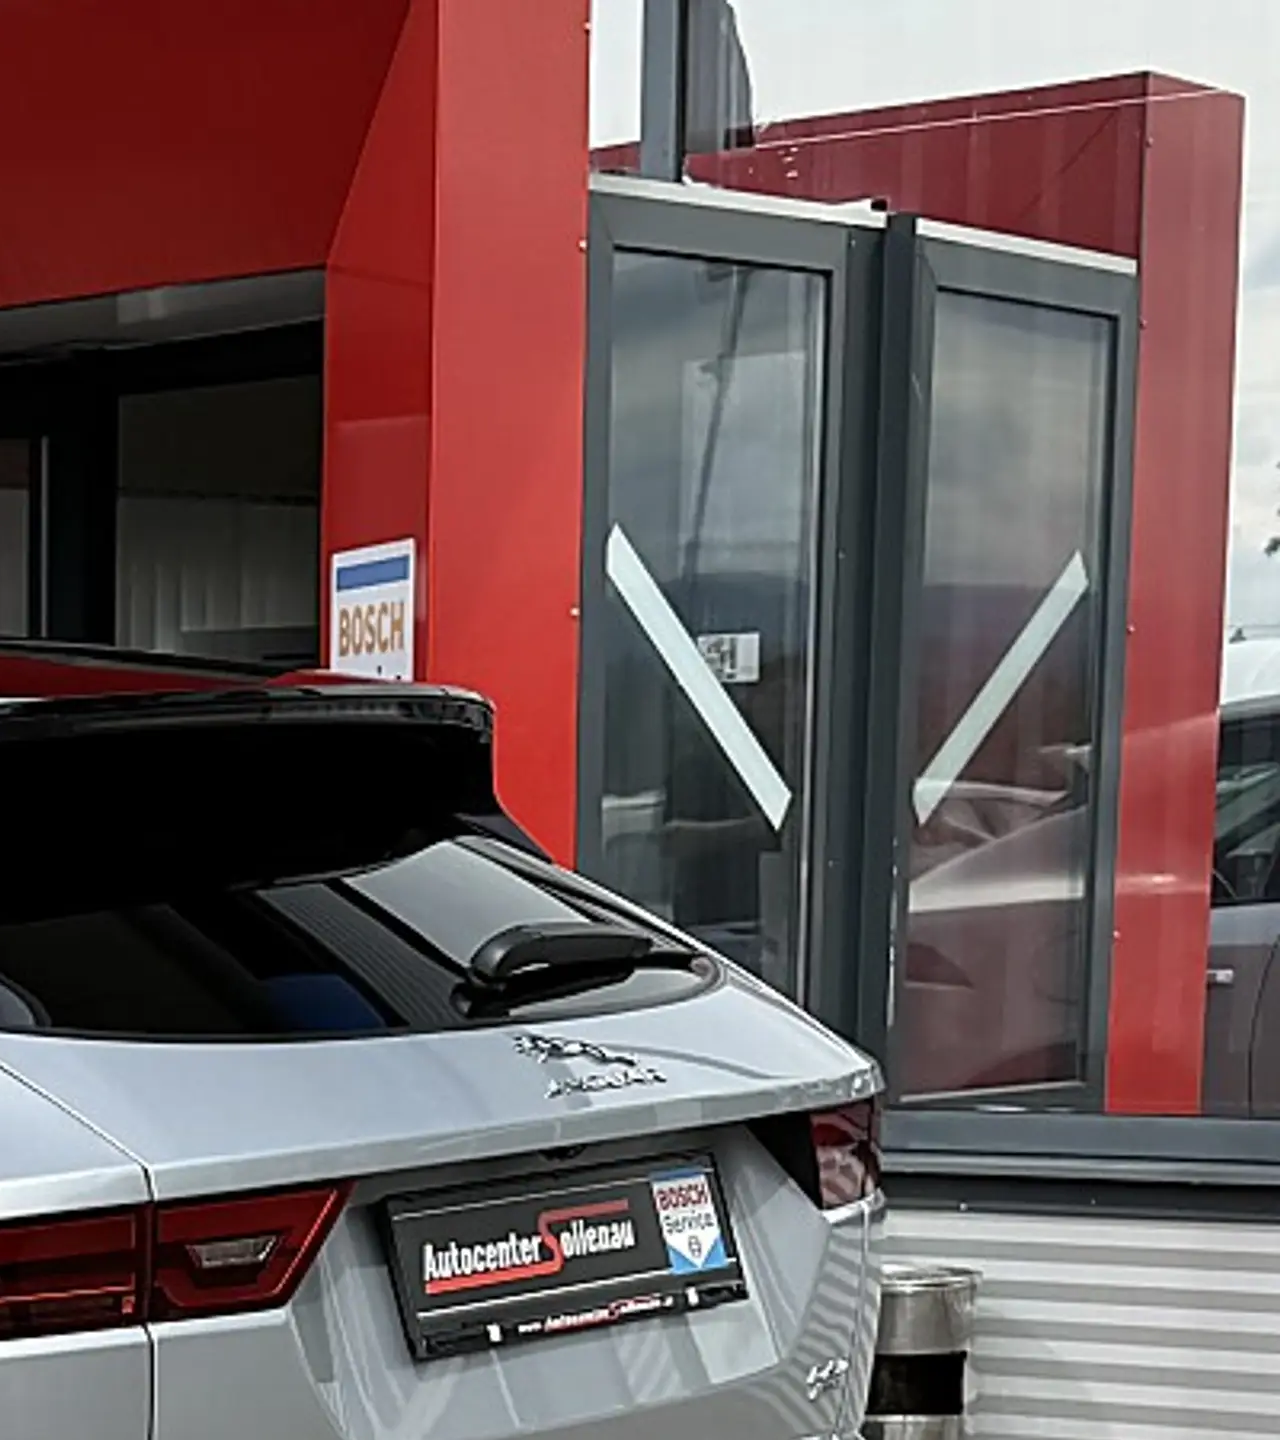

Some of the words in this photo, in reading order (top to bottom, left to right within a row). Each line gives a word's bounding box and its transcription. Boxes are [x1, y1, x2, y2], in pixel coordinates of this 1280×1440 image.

[339, 600, 405, 657] BOSCH
[654, 1181, 709, 1210] BOSCH
[661, 1208, 714, 1235] Service
